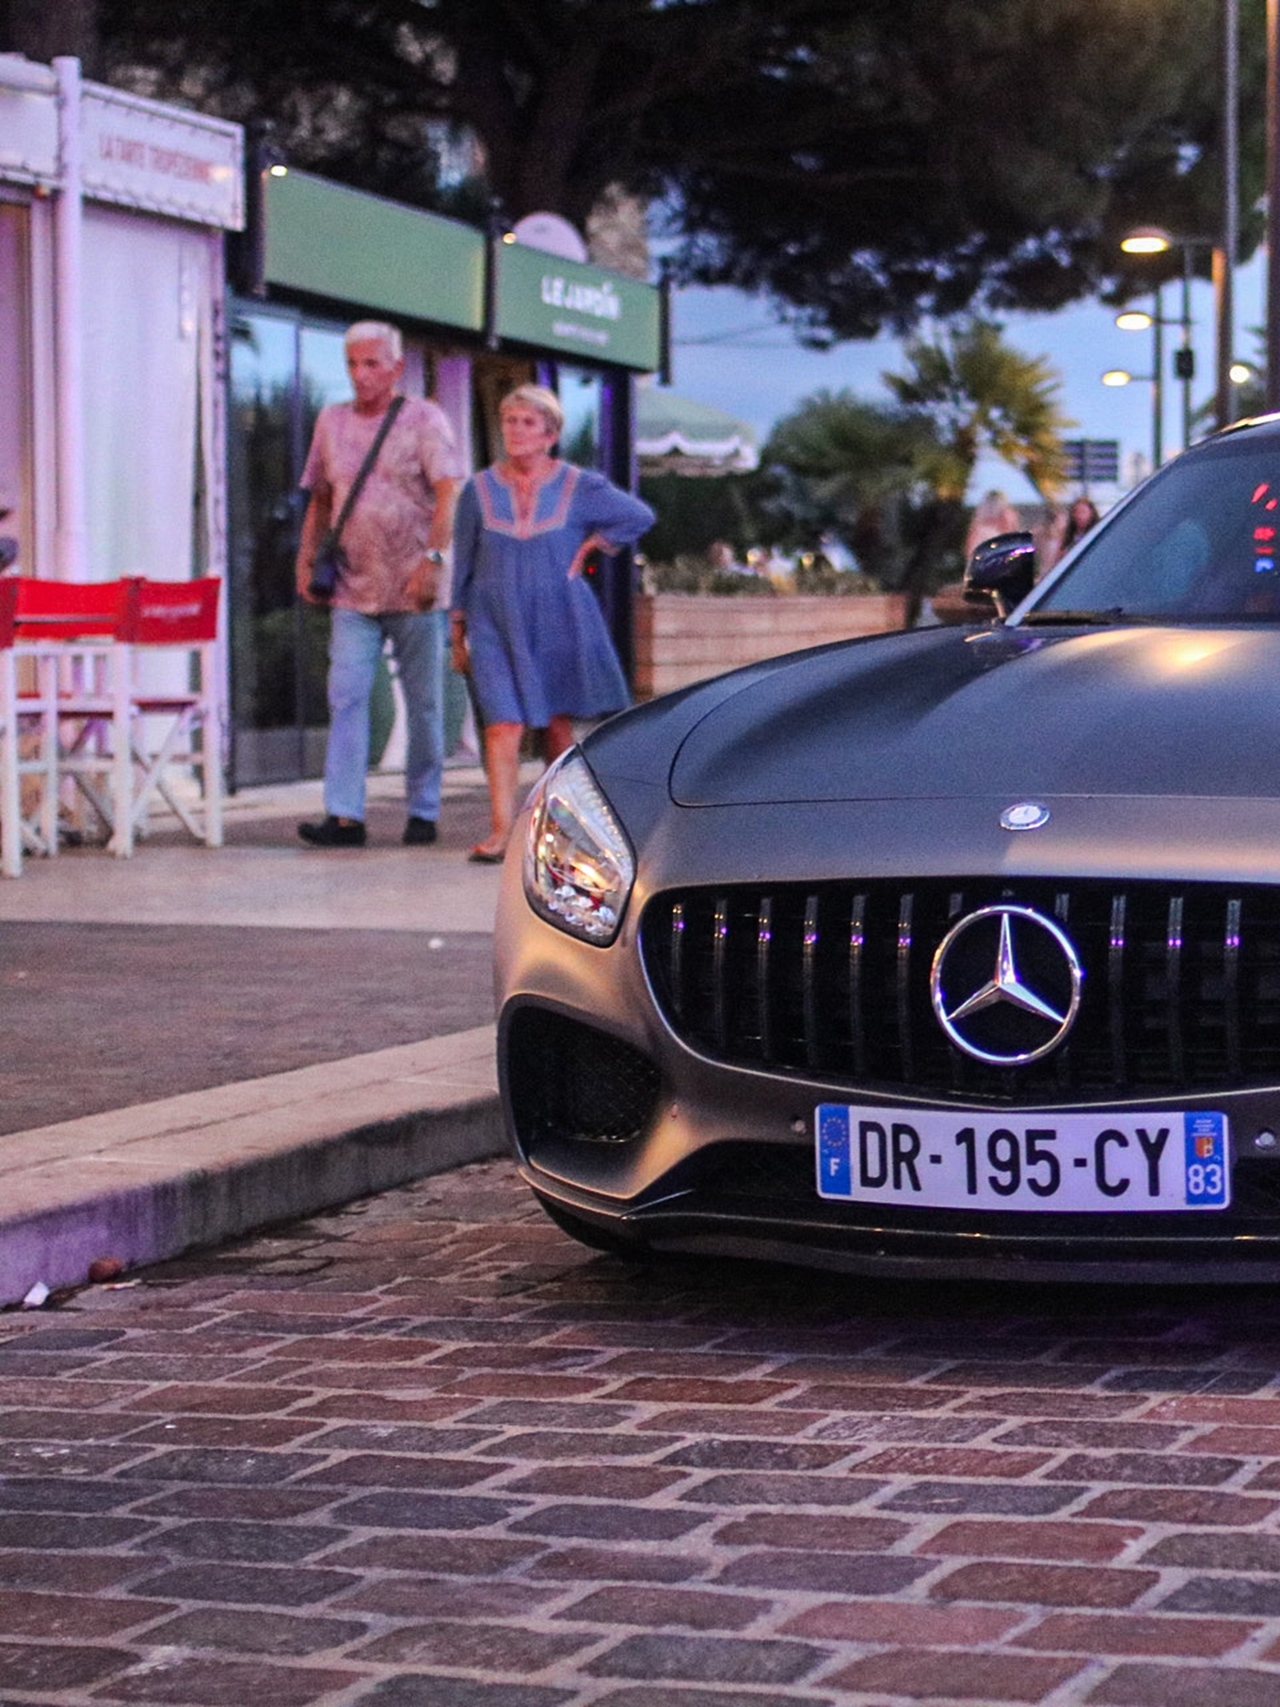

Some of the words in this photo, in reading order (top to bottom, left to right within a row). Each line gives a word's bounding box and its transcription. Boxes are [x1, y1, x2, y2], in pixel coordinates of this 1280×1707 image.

[829, 1157, 841, 1177] F
[858, 1120, 1170, 1197] DR-195-CY
[1188, 1163, 1223, 1195] 83
